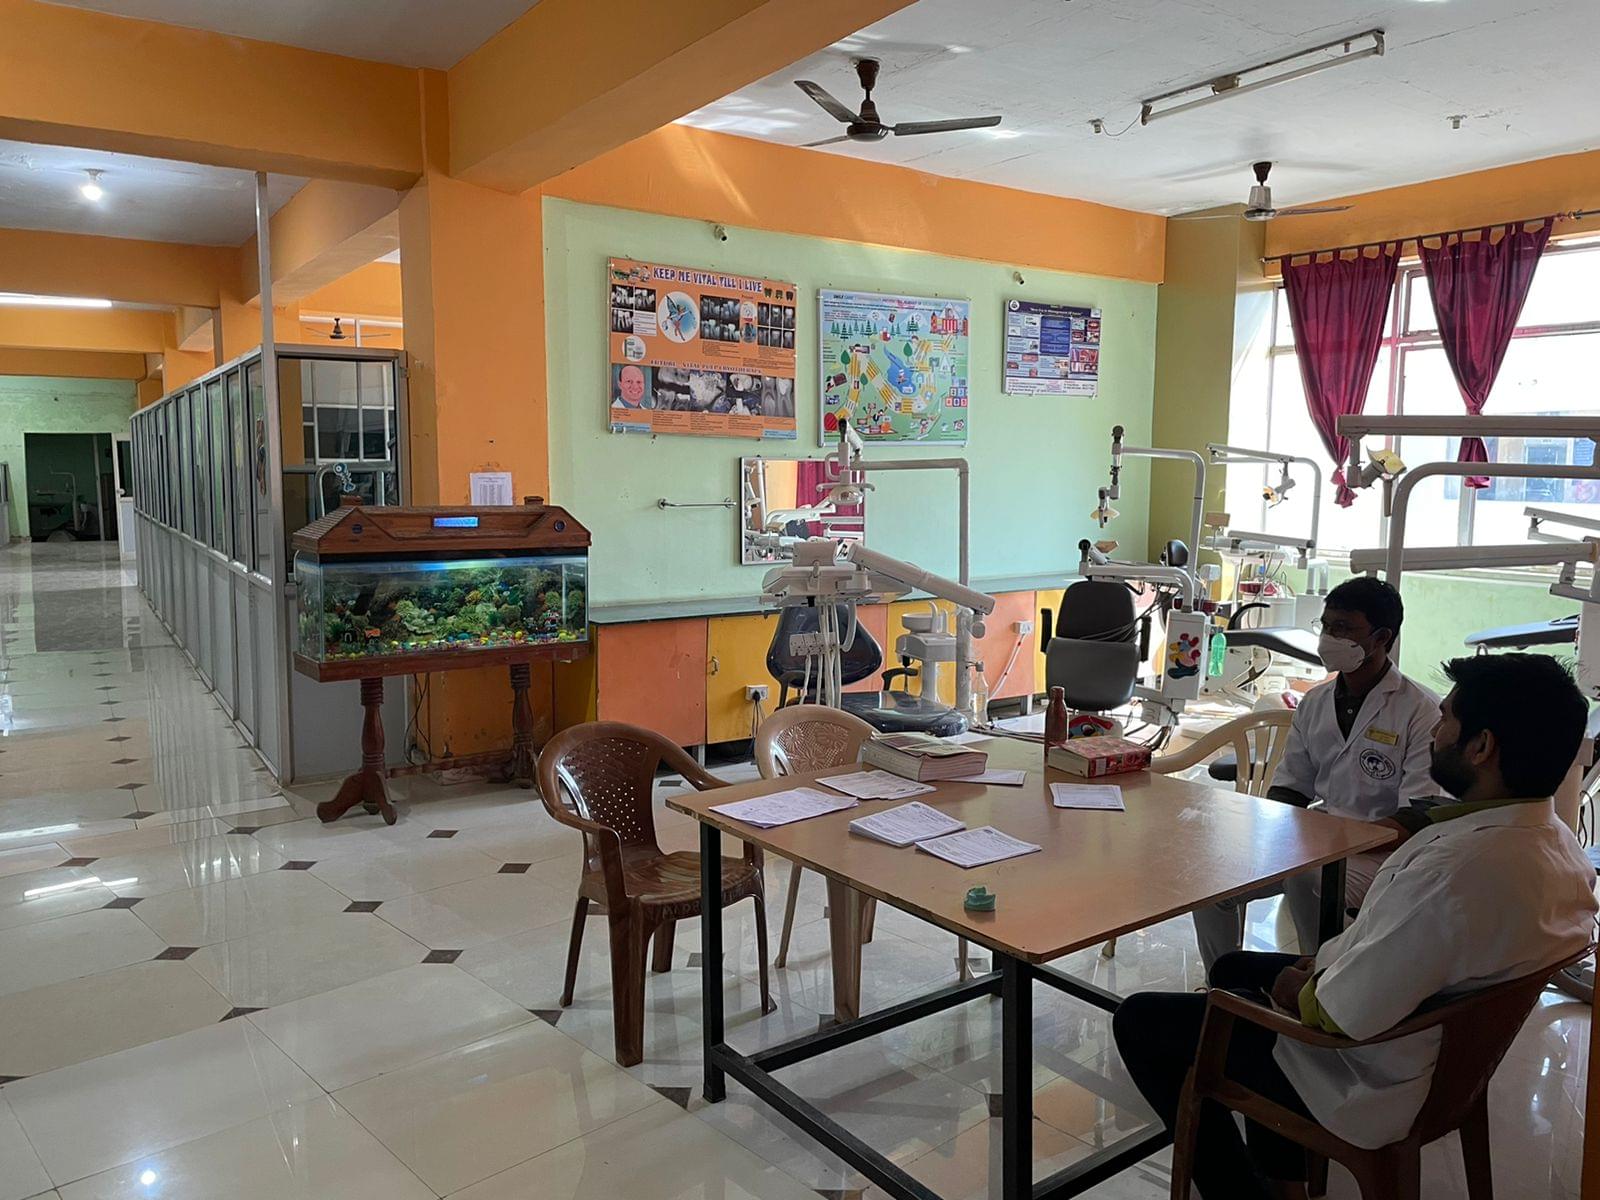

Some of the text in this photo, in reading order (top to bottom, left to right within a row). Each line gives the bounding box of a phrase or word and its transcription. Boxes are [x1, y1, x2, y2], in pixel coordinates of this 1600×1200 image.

[653, 267, 675, 280] KEEP
[678, 270, 690, 282] ME
[693, 272, 717, 285] VITAL
[719, 276, 736, 288] TILL
[744, 280, 762, 292] LIVE
